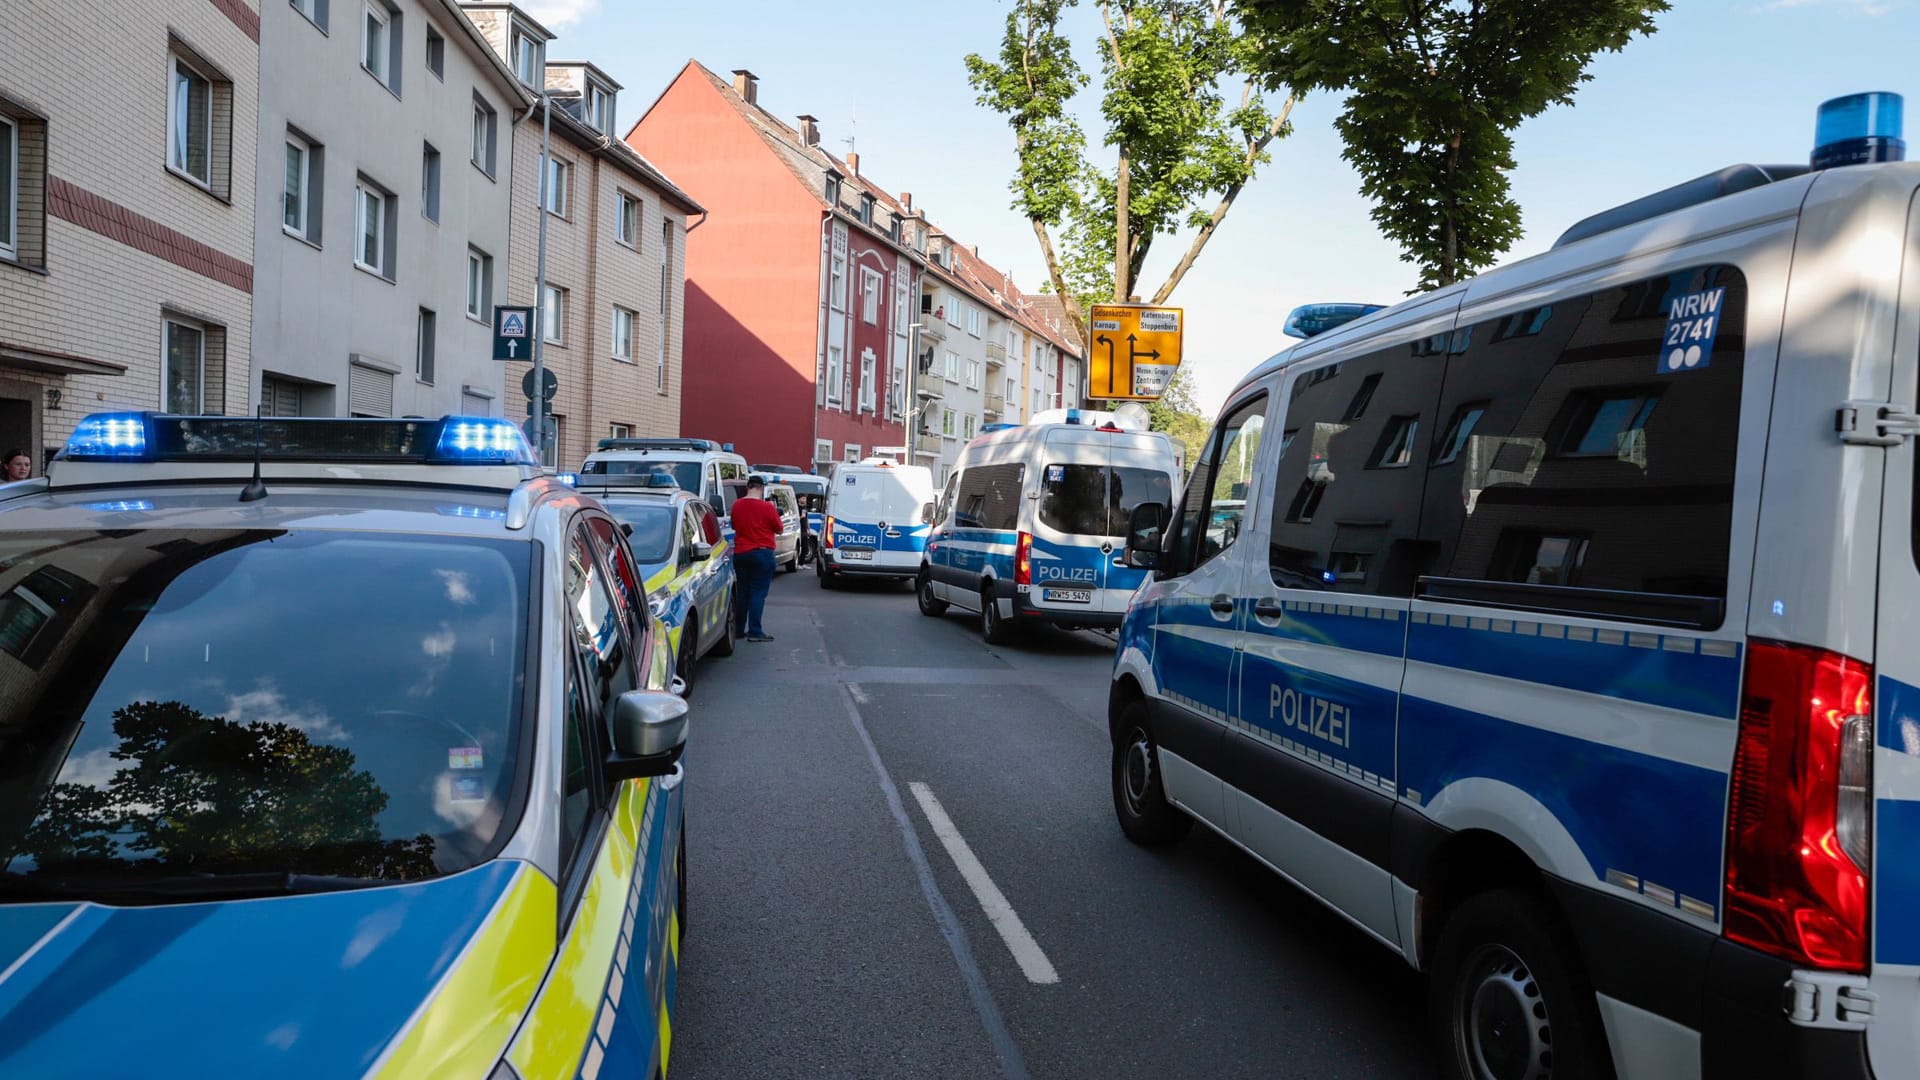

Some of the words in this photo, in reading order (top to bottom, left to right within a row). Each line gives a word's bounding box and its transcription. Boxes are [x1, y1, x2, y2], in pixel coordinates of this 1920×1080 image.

[1670, 289, 1722, 320] NRW
[1141, 311, 1175, 321] Katernberg
[1094, 321, 1116, 330] Karnap
[1140, 322, 1178, 332] Stoppenberg
[1667, 316, 1714, 345] 2741
[1136, 375, 1161, 384] Zentrum
[838, 534, 876, 544] POLIZEI
[1039, 566, 1098, 582] POLIZEI
[1270, 683, 1351, 749] POLIZEI
